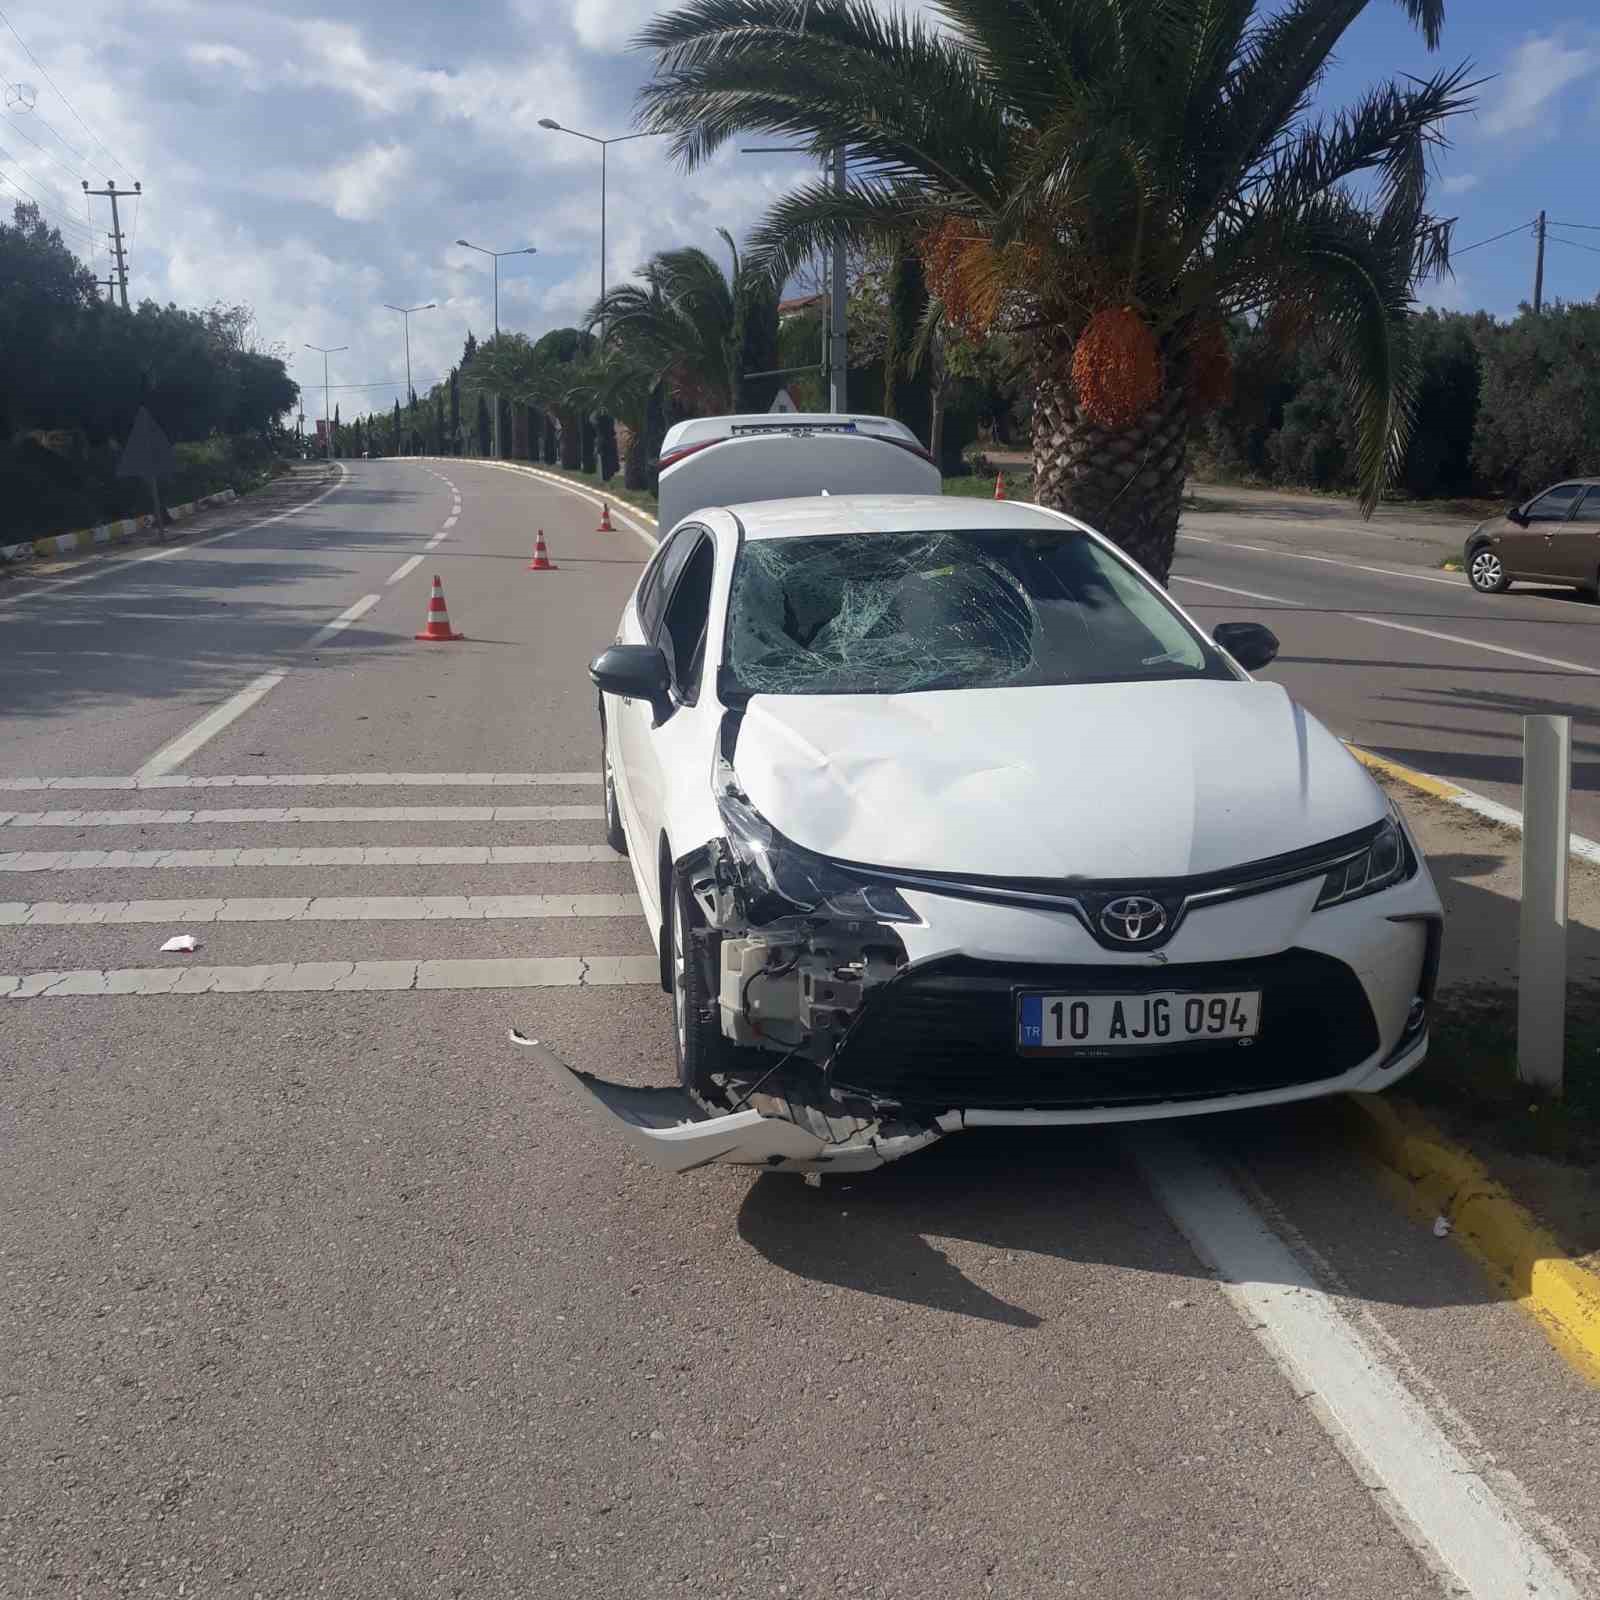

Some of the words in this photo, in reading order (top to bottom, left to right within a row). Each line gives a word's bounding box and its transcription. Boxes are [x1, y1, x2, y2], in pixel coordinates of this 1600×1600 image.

[1024, 1026, 1040, 1038] TR
[1050, 1001, 1089, 1040] 10
[1109, 998, 1170, 1039] AJG
[1185, 997, 1247, 1034] 094
